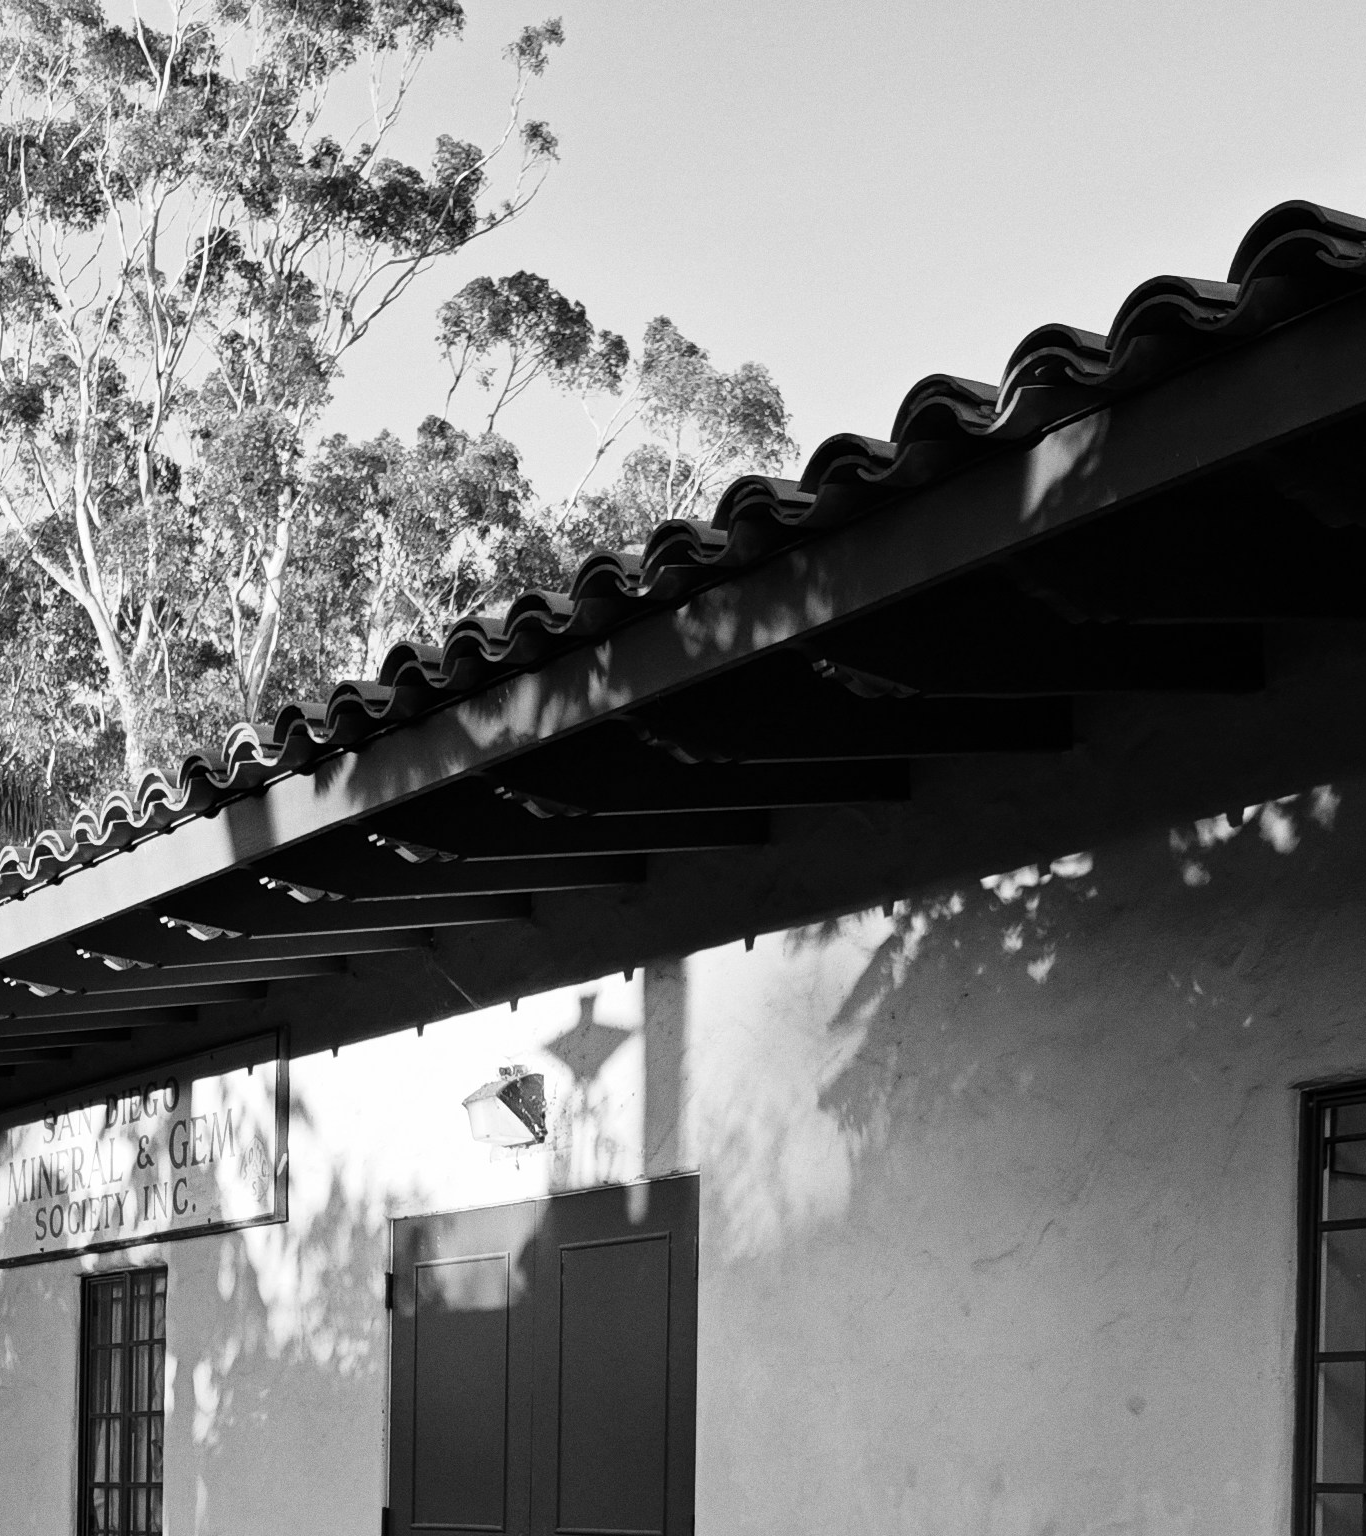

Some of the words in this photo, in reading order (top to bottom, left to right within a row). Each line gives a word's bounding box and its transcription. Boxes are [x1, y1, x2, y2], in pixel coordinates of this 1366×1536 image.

[43, 1098, 94, 1144] SAN
[105, 1076, 180, 1129] DIEGO
[7, 1137, 124, 1206] MINERAL
[136, 1134, 155, 1170] &
[168, 1108, 236, 1170] GEM
[35, 1190, 130, 1241] SOCIETY
[143, 1177, 197, 1221] INC.
